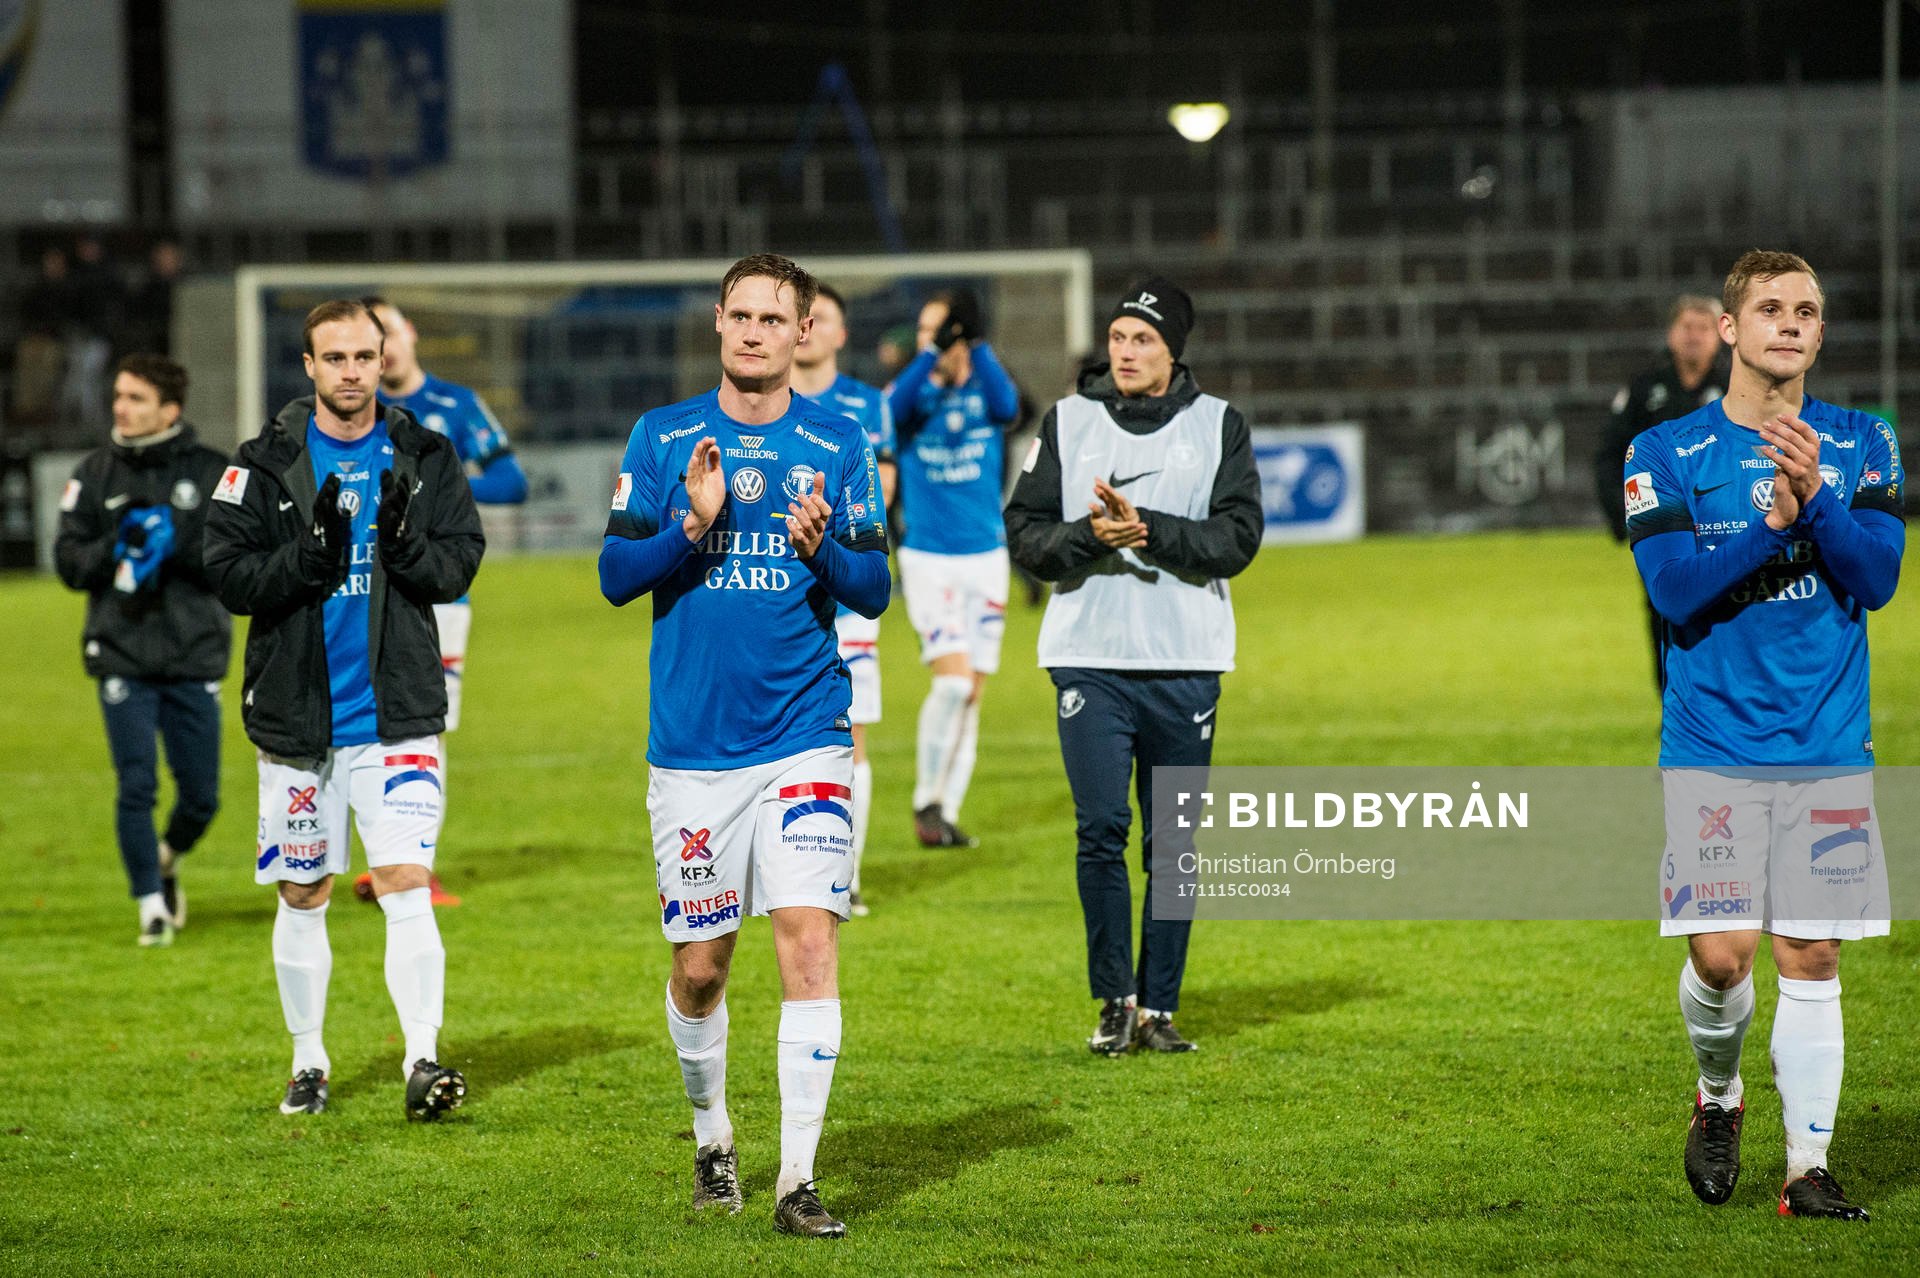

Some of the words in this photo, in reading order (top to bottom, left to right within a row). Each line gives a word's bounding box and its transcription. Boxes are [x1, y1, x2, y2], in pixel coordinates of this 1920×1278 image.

[1138, 291, 1158, 306] 17
[804, 430, 840, 454] Tillmobil
[725, 448, 778, 460] TRELLEBORG
[691, 530, 799, 558] MELLB
[705, 559, 790, 591] GÅRD
[288, 819, 318, 830] KFX
[283, 840, 328, 857] INTER
[782, 834, 827, 845] Trelleborgs
[829, 835, 848, 846] Hamn
[285, 853, 327, 870] SPORT
[1699, 846, 1736, 861] KFX
[681, 864, 716, 880] KFX
[1666, 853, 1675, 880] 5
[1810, 865, 1858, 877] Trelleborgs
[1696, 881, 1752, 900] INTER
[683, 889, 738, 914] INTER
[1697, 899, 1752, 916] SPORT
[686, 904, 740, 928] SPORT
